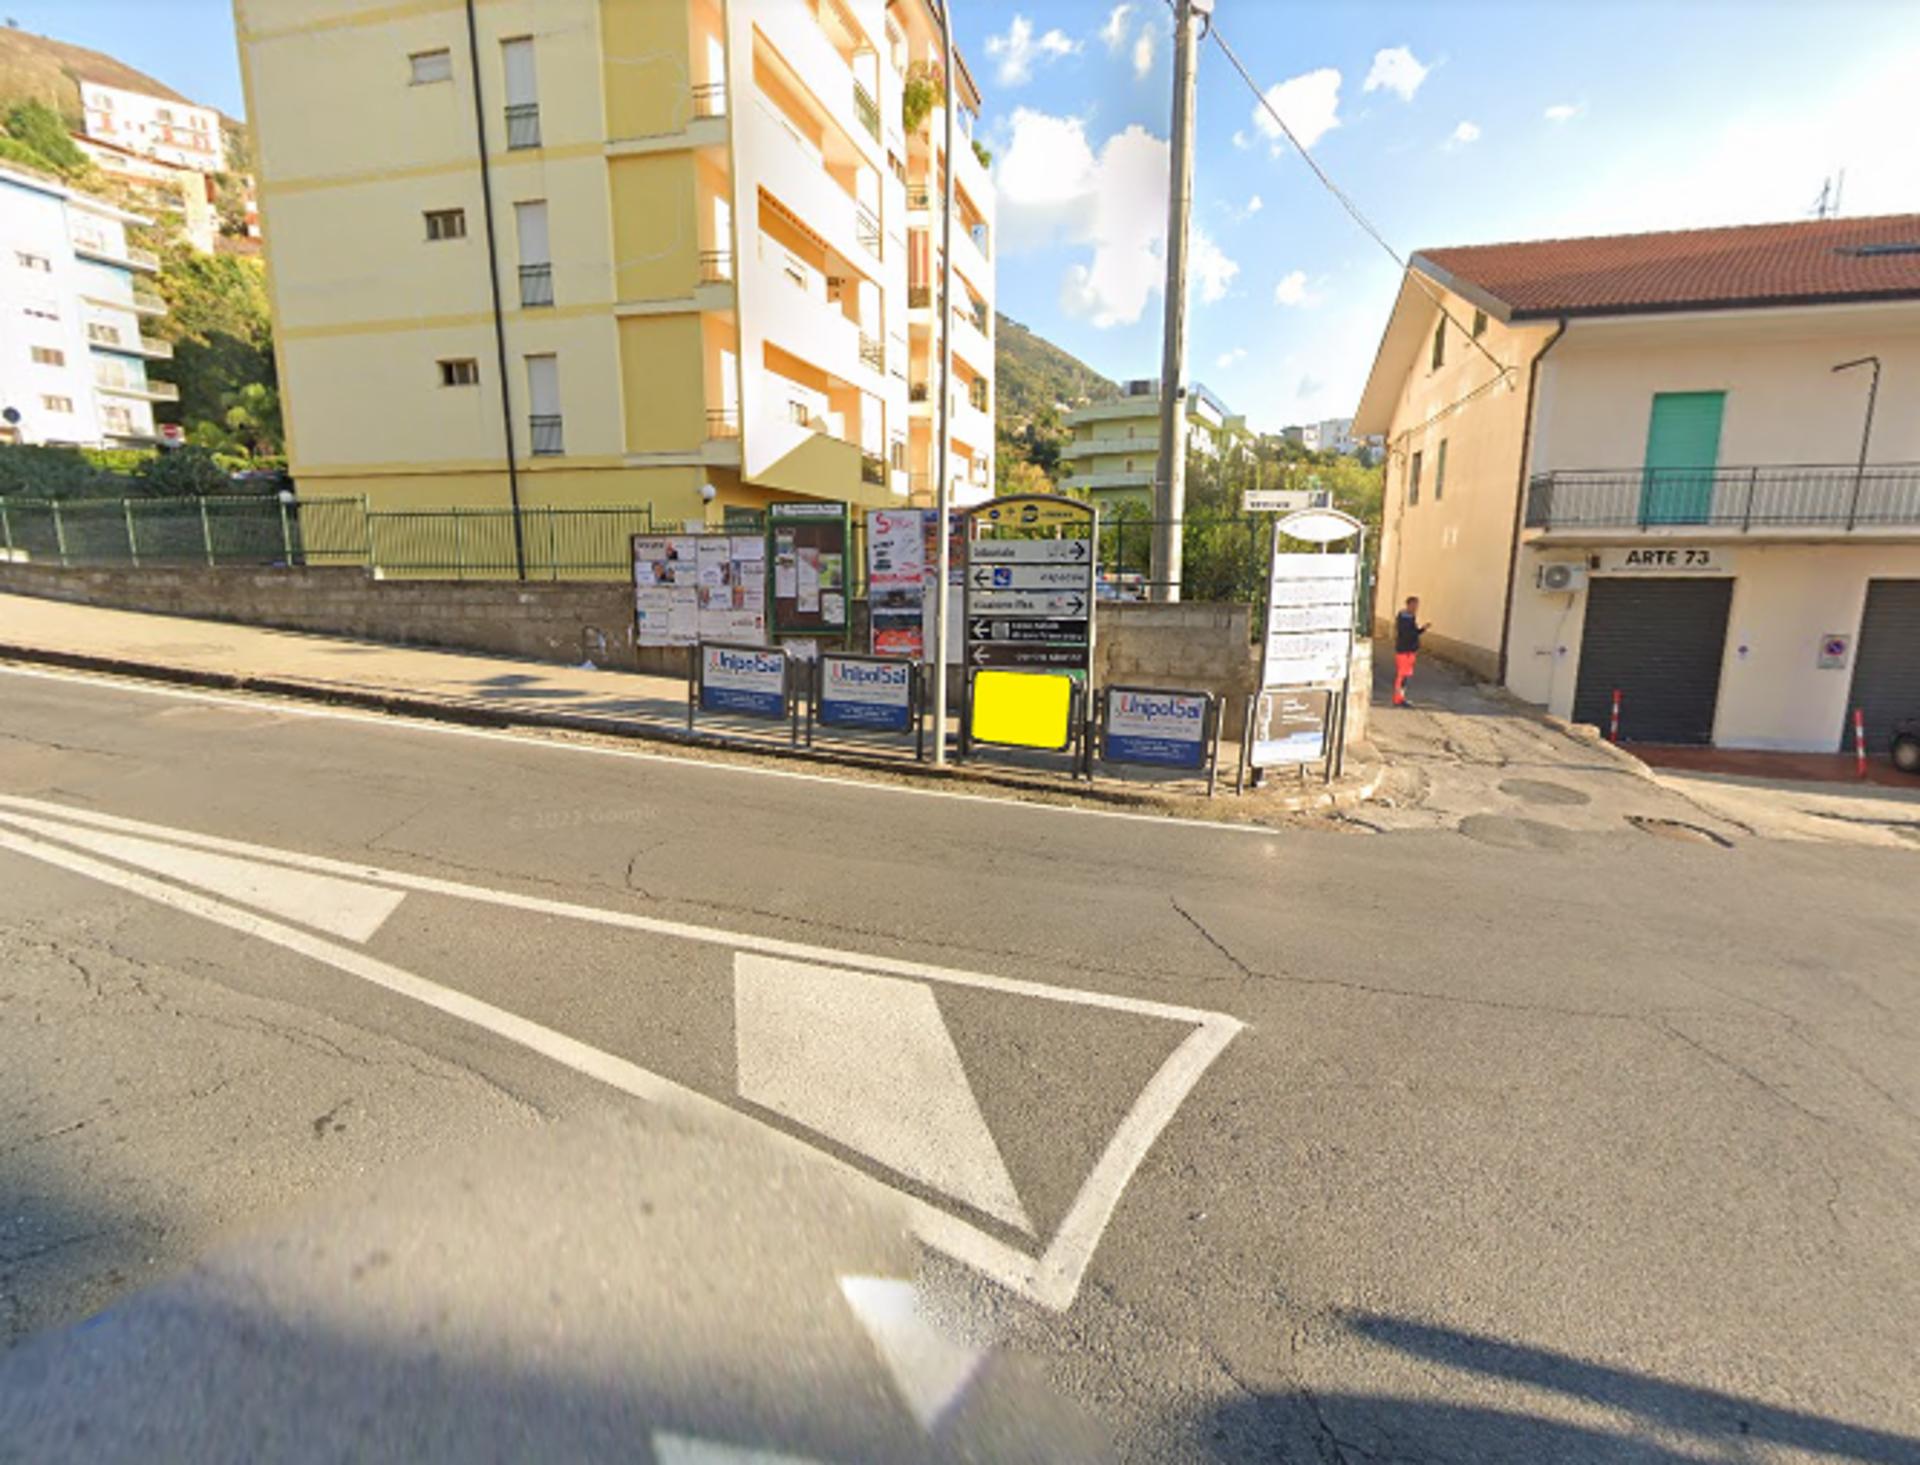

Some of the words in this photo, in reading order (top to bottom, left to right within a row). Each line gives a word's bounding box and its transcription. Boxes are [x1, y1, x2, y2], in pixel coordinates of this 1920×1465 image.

[1625, 549, 1678, 566] ARTE
[1685, 549, 1711, 566] 73
[711, 650, 782, 675] UnipolSai
[832, 662, 907, 686] UnipolSai
[1120, 693, 1202, 721] UnipolSai
